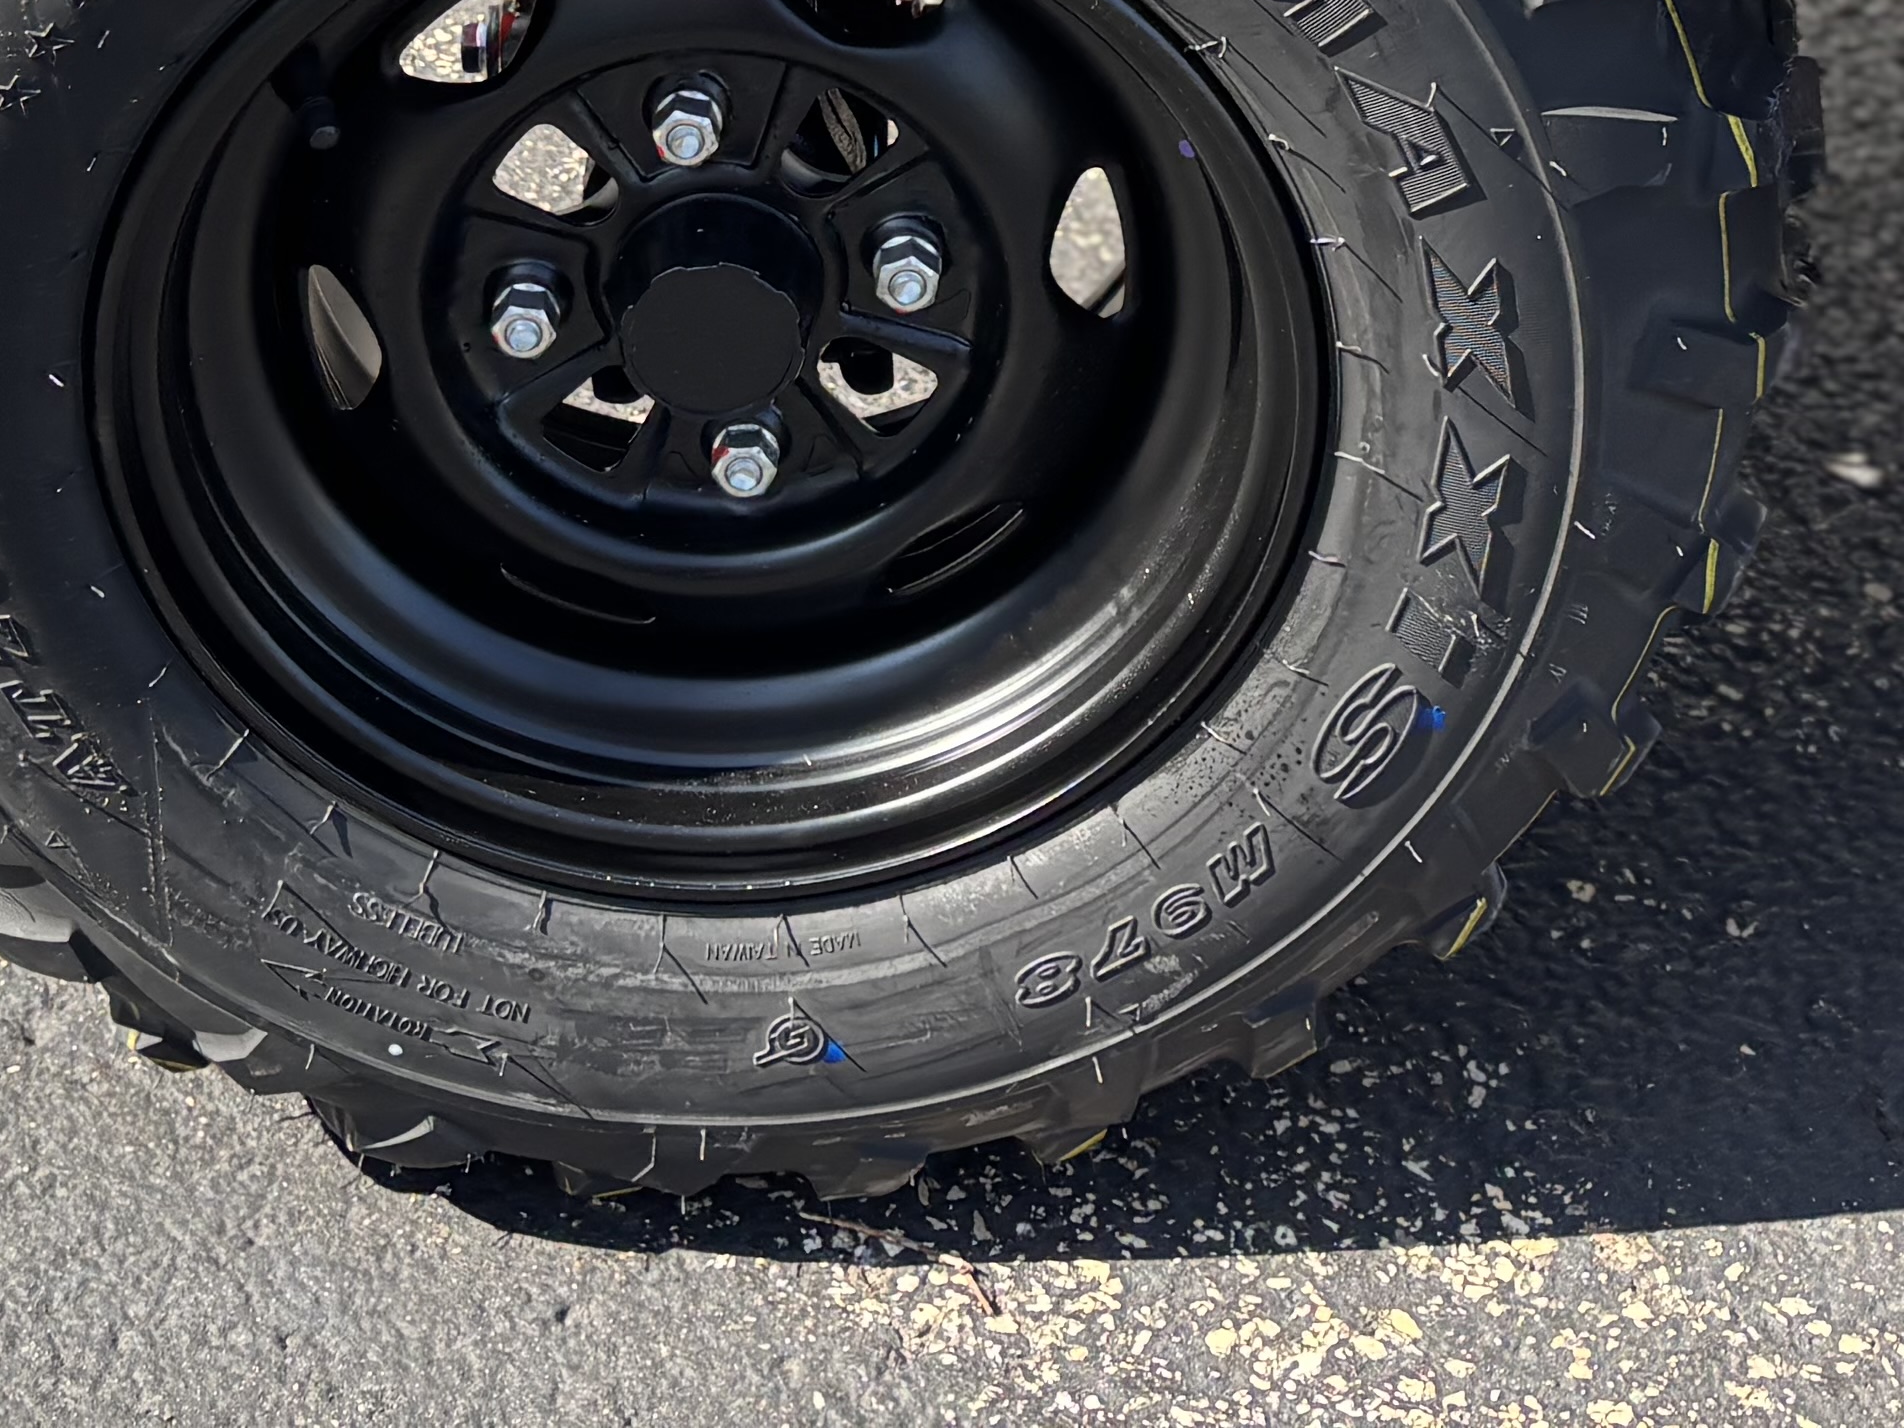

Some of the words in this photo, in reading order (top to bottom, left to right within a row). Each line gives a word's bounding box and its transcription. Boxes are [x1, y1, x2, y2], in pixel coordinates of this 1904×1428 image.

[1012, 823, 1277, 1010] M978
[416, 973, 471, 1010] FOR
[475, 993, 532, 1024] NOT
